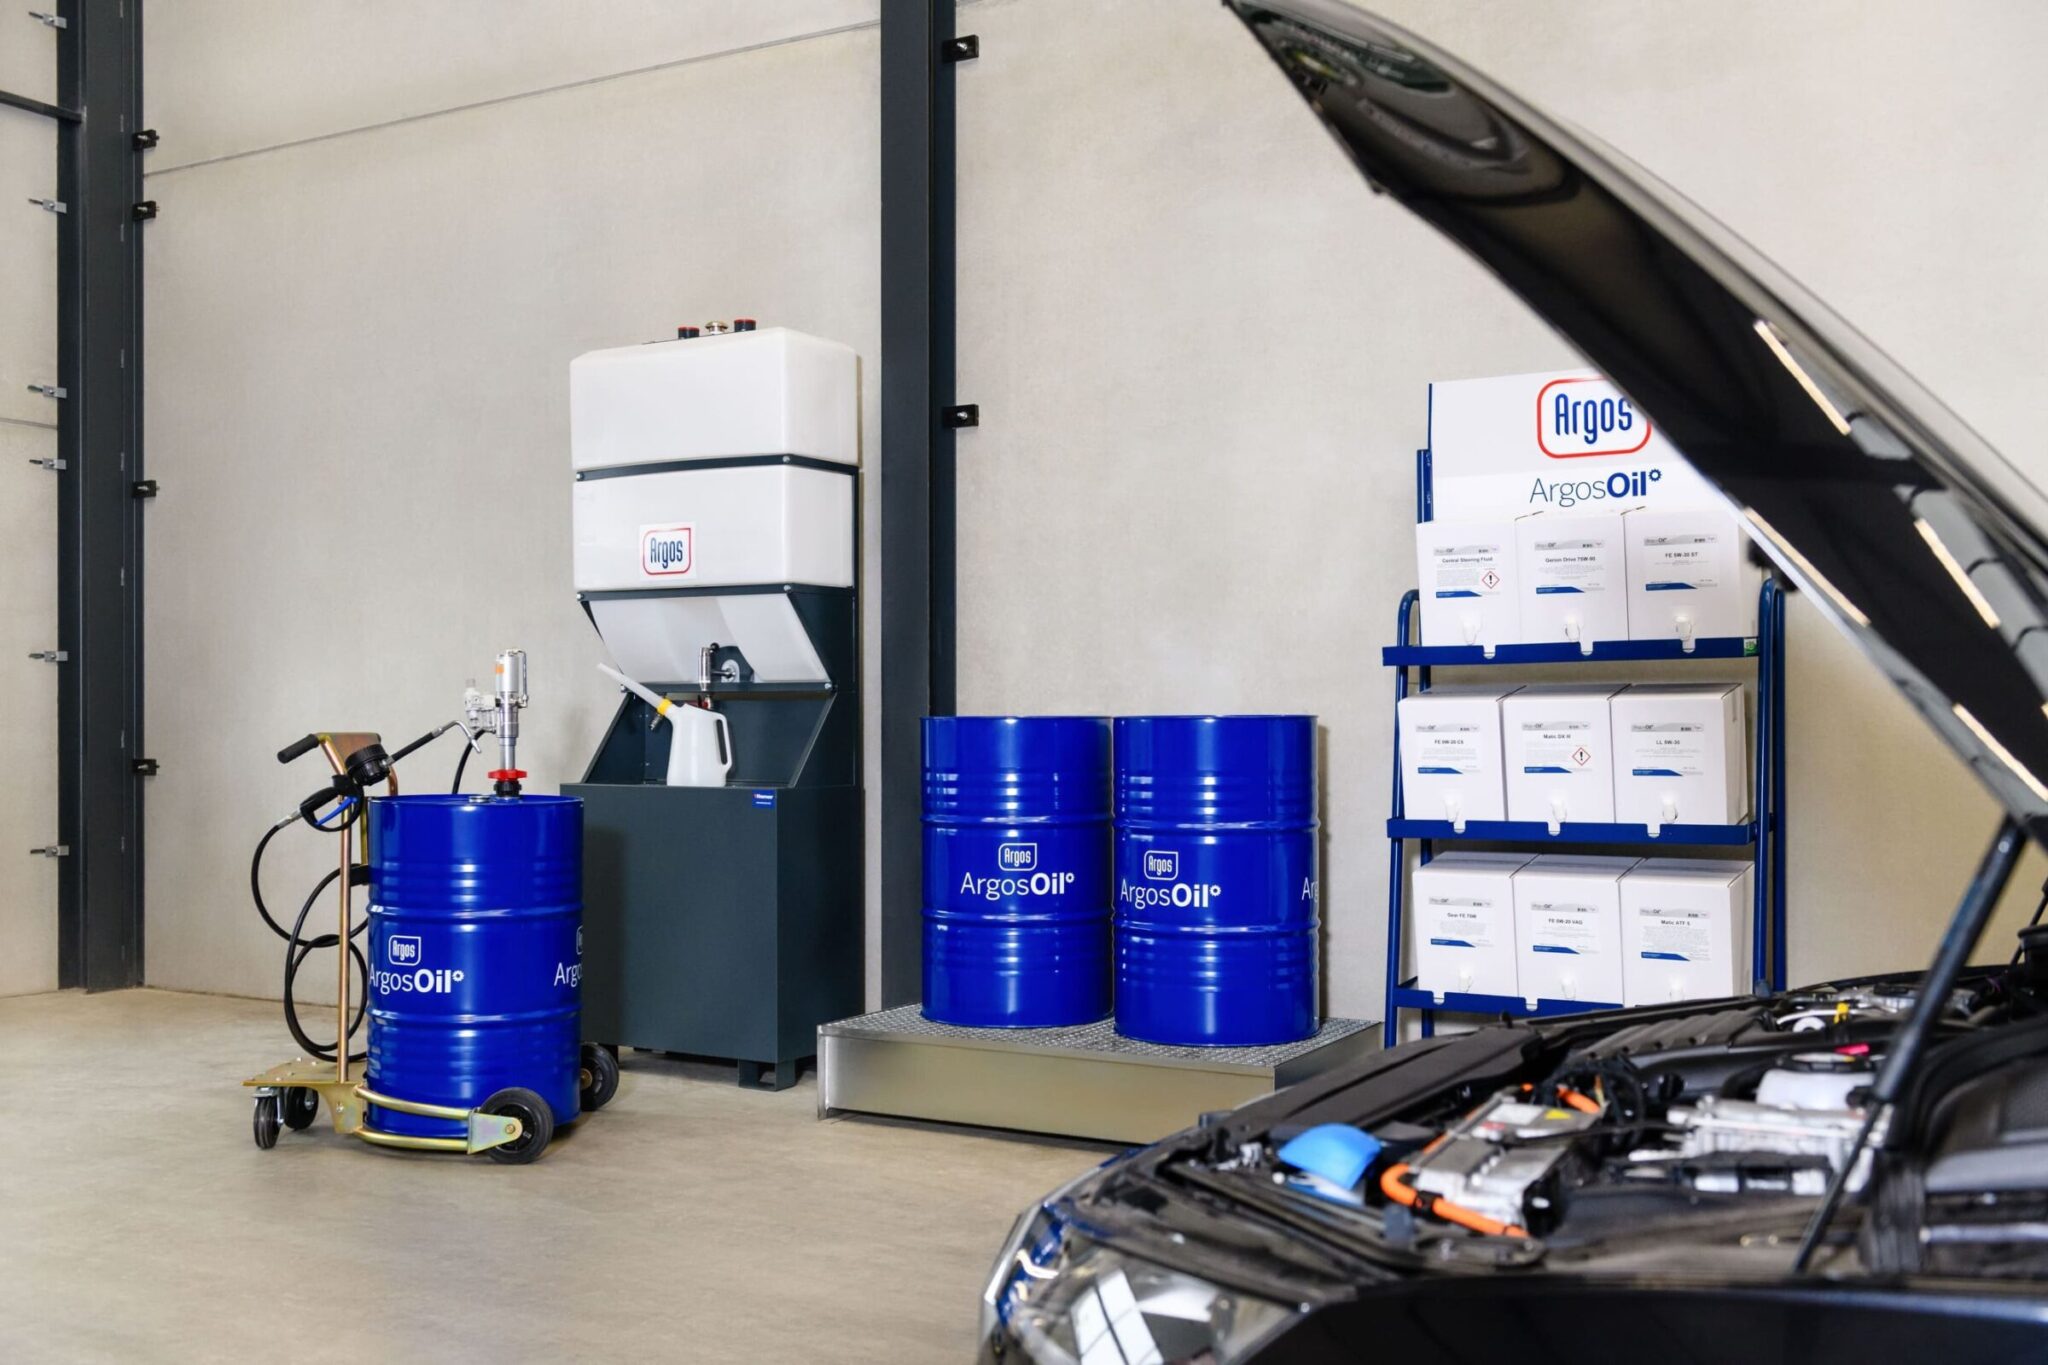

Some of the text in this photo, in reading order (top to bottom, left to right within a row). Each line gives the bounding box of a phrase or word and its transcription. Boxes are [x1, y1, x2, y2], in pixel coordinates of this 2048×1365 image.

[1554, 392, 1633, 445] Argos
[650, 537, 684, 570] Argos
[1004, 847, 1032, 868] Argos
[1148, 855, 1173, 877] Argos
[392, 939, 416, 962] Argos
